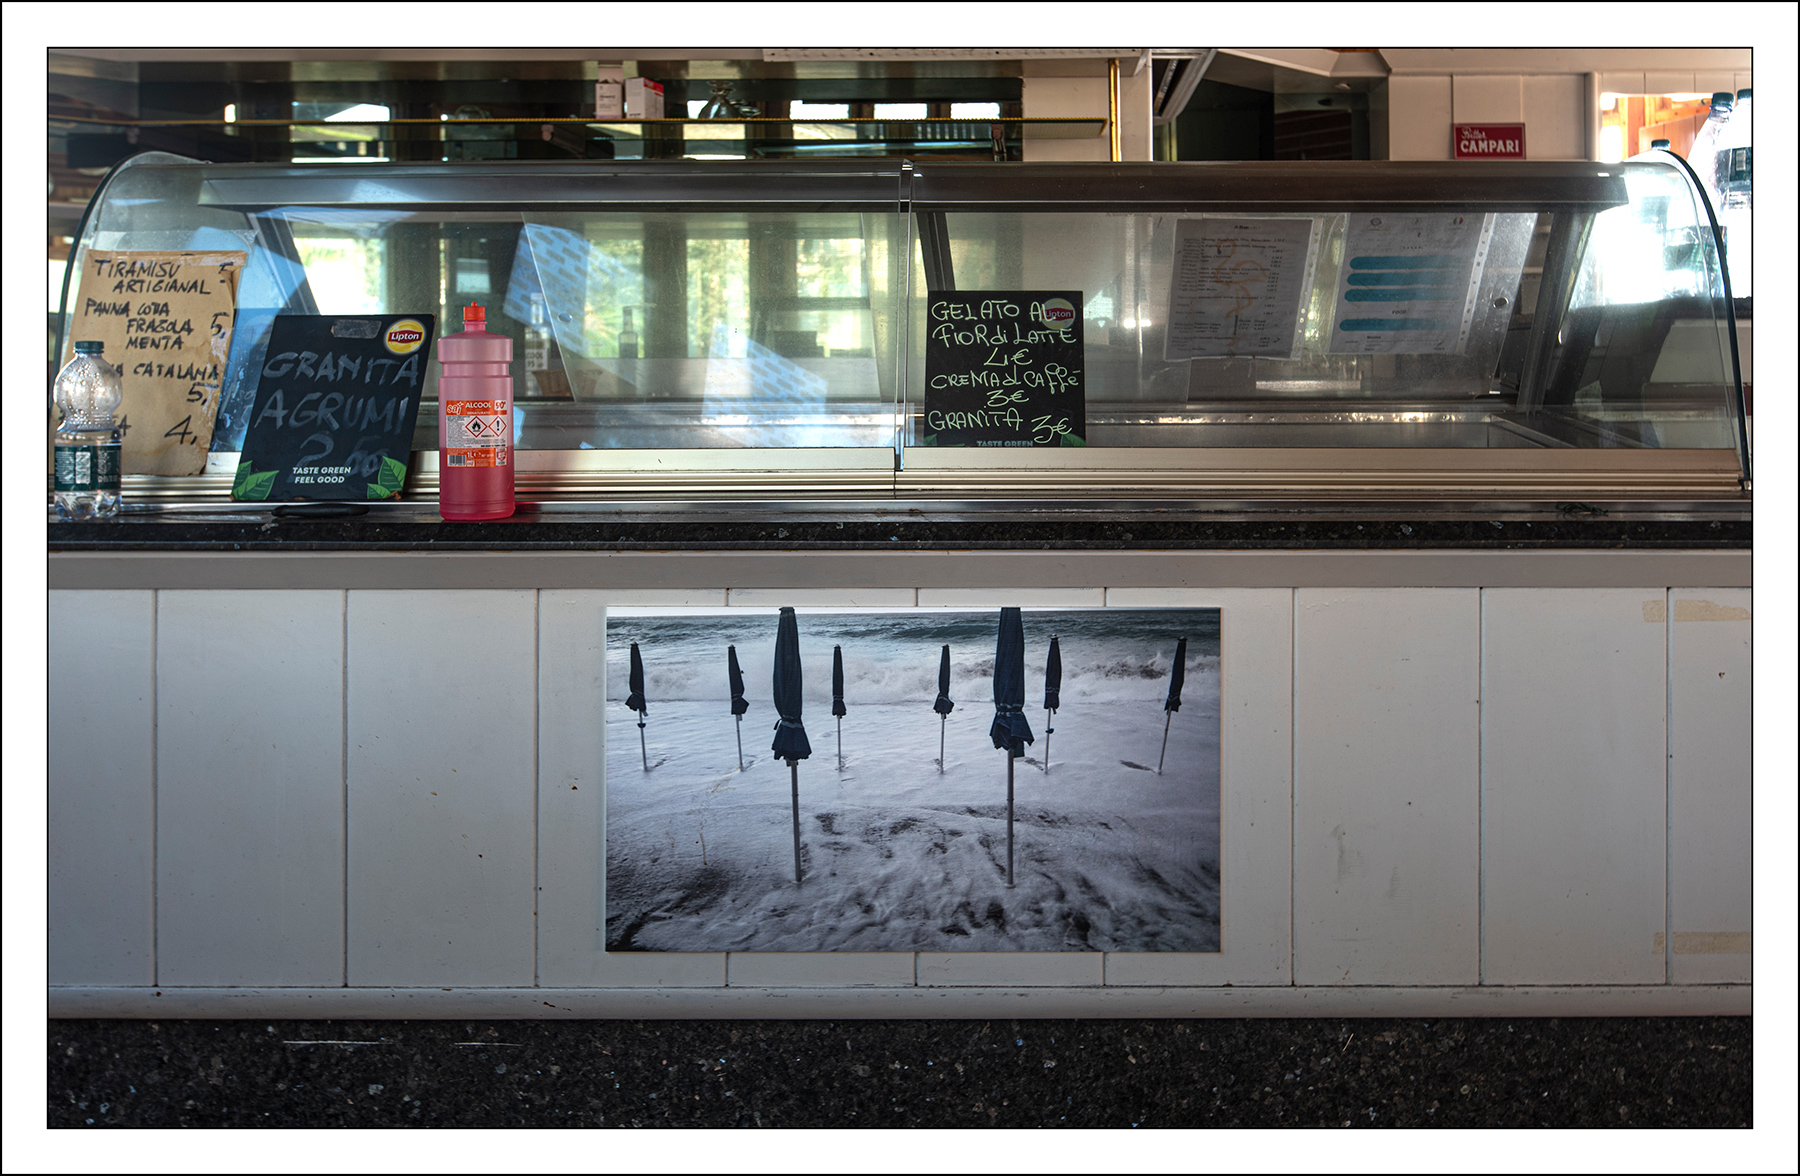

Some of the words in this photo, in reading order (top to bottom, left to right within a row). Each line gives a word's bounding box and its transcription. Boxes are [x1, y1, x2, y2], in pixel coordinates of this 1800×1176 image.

[1460, 139, 1520, 153] CAMPARI
[84, 297, 131, 318] PANNA
[931, 299, 1020, 321] GELATO
[1029, 301, 1056, 322] AL
[1045, 309, 1072, 318] Lipton
[125, 335, 184, 350] MENTA
[391, 332, 419, 341] Lipton
[1012, 322, 1076, 345] LATTE
[133, 361, 219, 380] CATALANA
[262, 350, 419, 388] GRANITA
[930, 369, 1000, 389] CREMA
[254, 388, 409, 435] AGRUMI
[928, 407, 1024, 431] GRANITA
[292, 466, 319, 475] TASTE
[320, 466, 351, 475] GREEN
[294, 476, 315, 484] FEEL
[317, 476, 345, 484] GOOD
